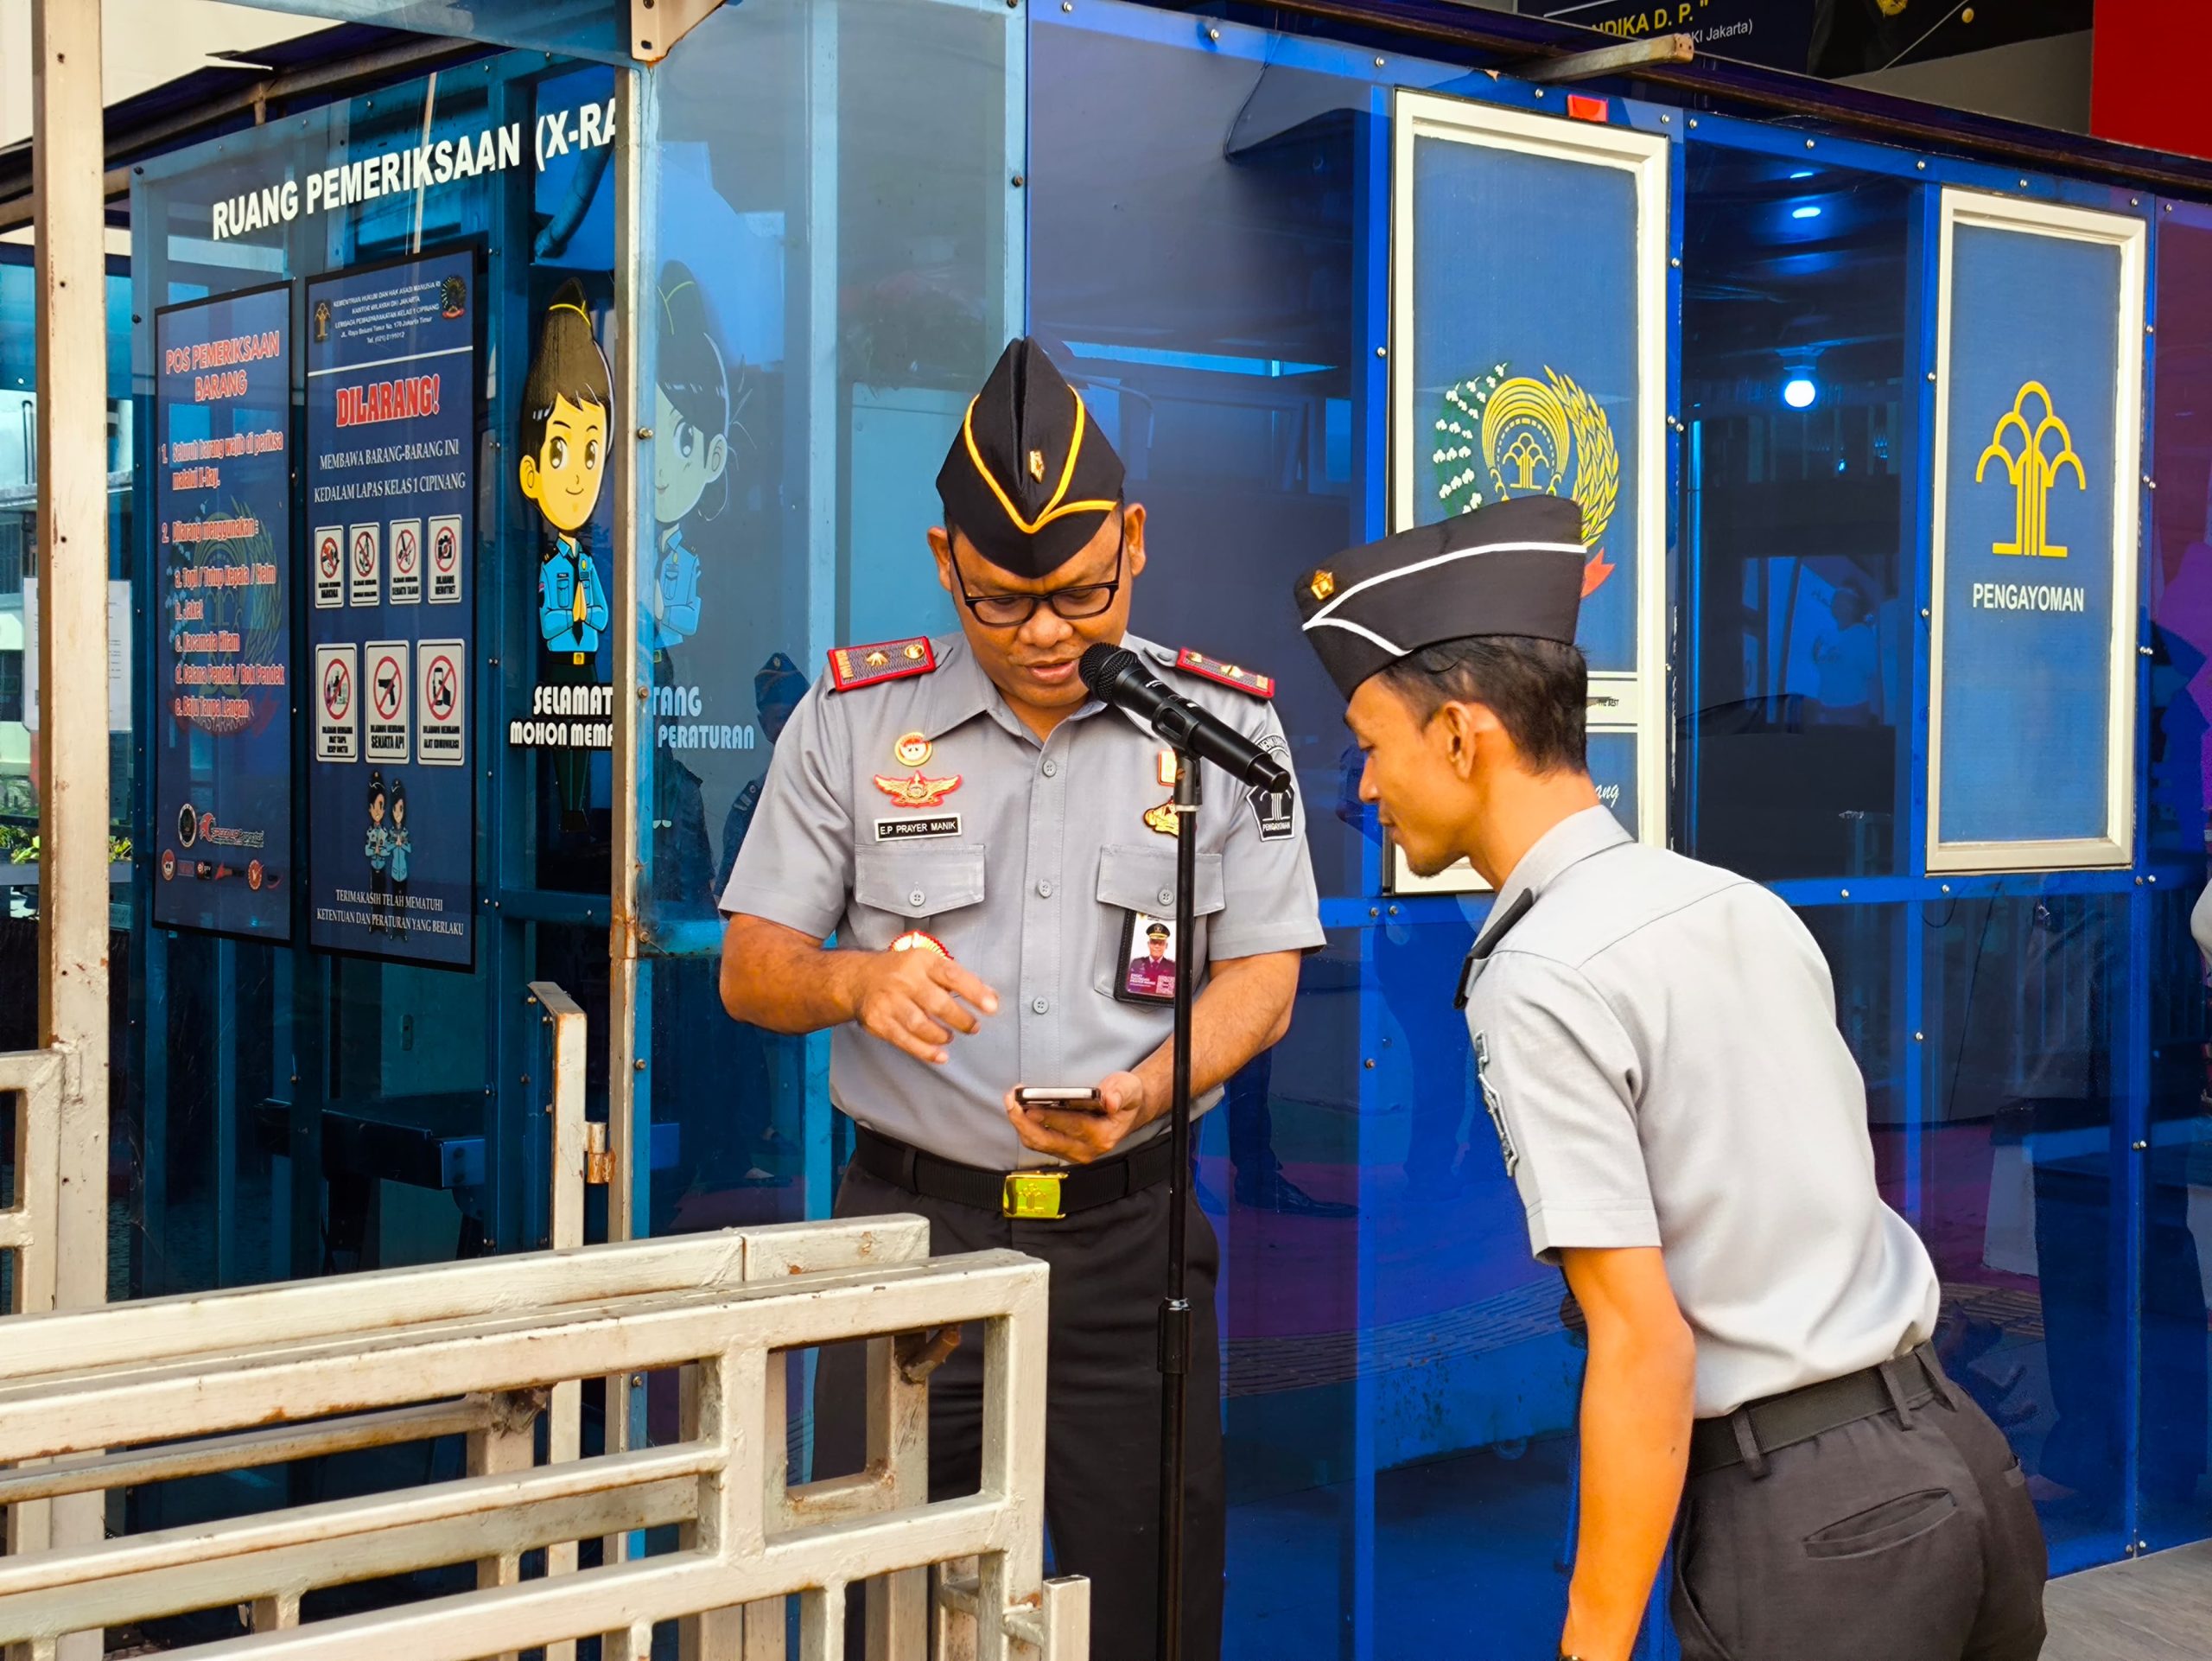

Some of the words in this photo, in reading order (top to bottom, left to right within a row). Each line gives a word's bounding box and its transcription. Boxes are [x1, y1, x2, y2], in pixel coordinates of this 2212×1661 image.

[1654, 10, 1672, 29] D.
[1678, 3, 1693, 23] P.
[1706, 18, 1753, 41] Jakarta)
[213, 181, 298, 241] RUANG
[307, 123, 520, 215] PEMERIKSAAN
[166, 346, 189, 374] POS
[193, 330, 280, 370] PEMERIKSAAN
[195, 369, 247, 402] BARANG
[336, 373, 440, 428] DILARANG!
[162, 443, 168, 464] 1.
[200, 437, 225, 461] barang
[226, 434, 245, 457] wajib
[245, 431, 254, 454] di
[254, 430, 283, 456] periksa
[320, 451, 364, 470] MEMBAWA
[365, 440, 443, 465] BARANG-BARANG
[445, 439, 459, 455] INI
[315, 484, 355, 503] KEDALAM
[356, 480, 383, 499] LAPAS
[385, 477, 413, 495] KELAS
[420, 472, 466, 493] CIPINANG
[172, 520, 201, 543] Dilarang
[175, 570, 182, 589] a.
[183, 566, 198, 590] Topi
[203, 565, 223, 589] Tutup
[225, 564, 250, 589] Kepala
[256, 563, 276, 585] Helm
[183, 600, 203, 620] Jaket
[1973, 583, 2084, 612] PENGAYOMAN
[182, 631, 217, 652] Kacamata
[219, 630, 240, 652] Hitam
[175, 664, 182, 684] d.
[183, 663, 207, 684] Celana
[207, 663, 234, 684] Pendek
[241, 663, 255, 684] Rok
[257, 663, 285, 684] Pendek
[183, 695, 200, 720] Baju
[200, 695, 220, 720] Tanpa
[221, 696, 250, 720] Lengan
[533, 685, 613, 716] SELAMAT
[510, 721, 568, 746] MOHON
[658, 724, 753, 749] PERATURAN
[880, 825, 893, 835] E.P
[896, 823, 928, 833] PRAYER
[931, 821, 957, 831] MANIK
[335, 888, 381, 905] TERIMAKASIH
[382, 894, 405, 907] TELAH
[405, 896, 443, 911] MEMATUHI
[316, 908, 355, 924] KETENTUAN
[356, 912, 371, 926] DAN
[372, 913, 411, 930] PERATURAN
[412, 918, 432, 932] YANG
[432, 920, 464, 935] BERLAKU
